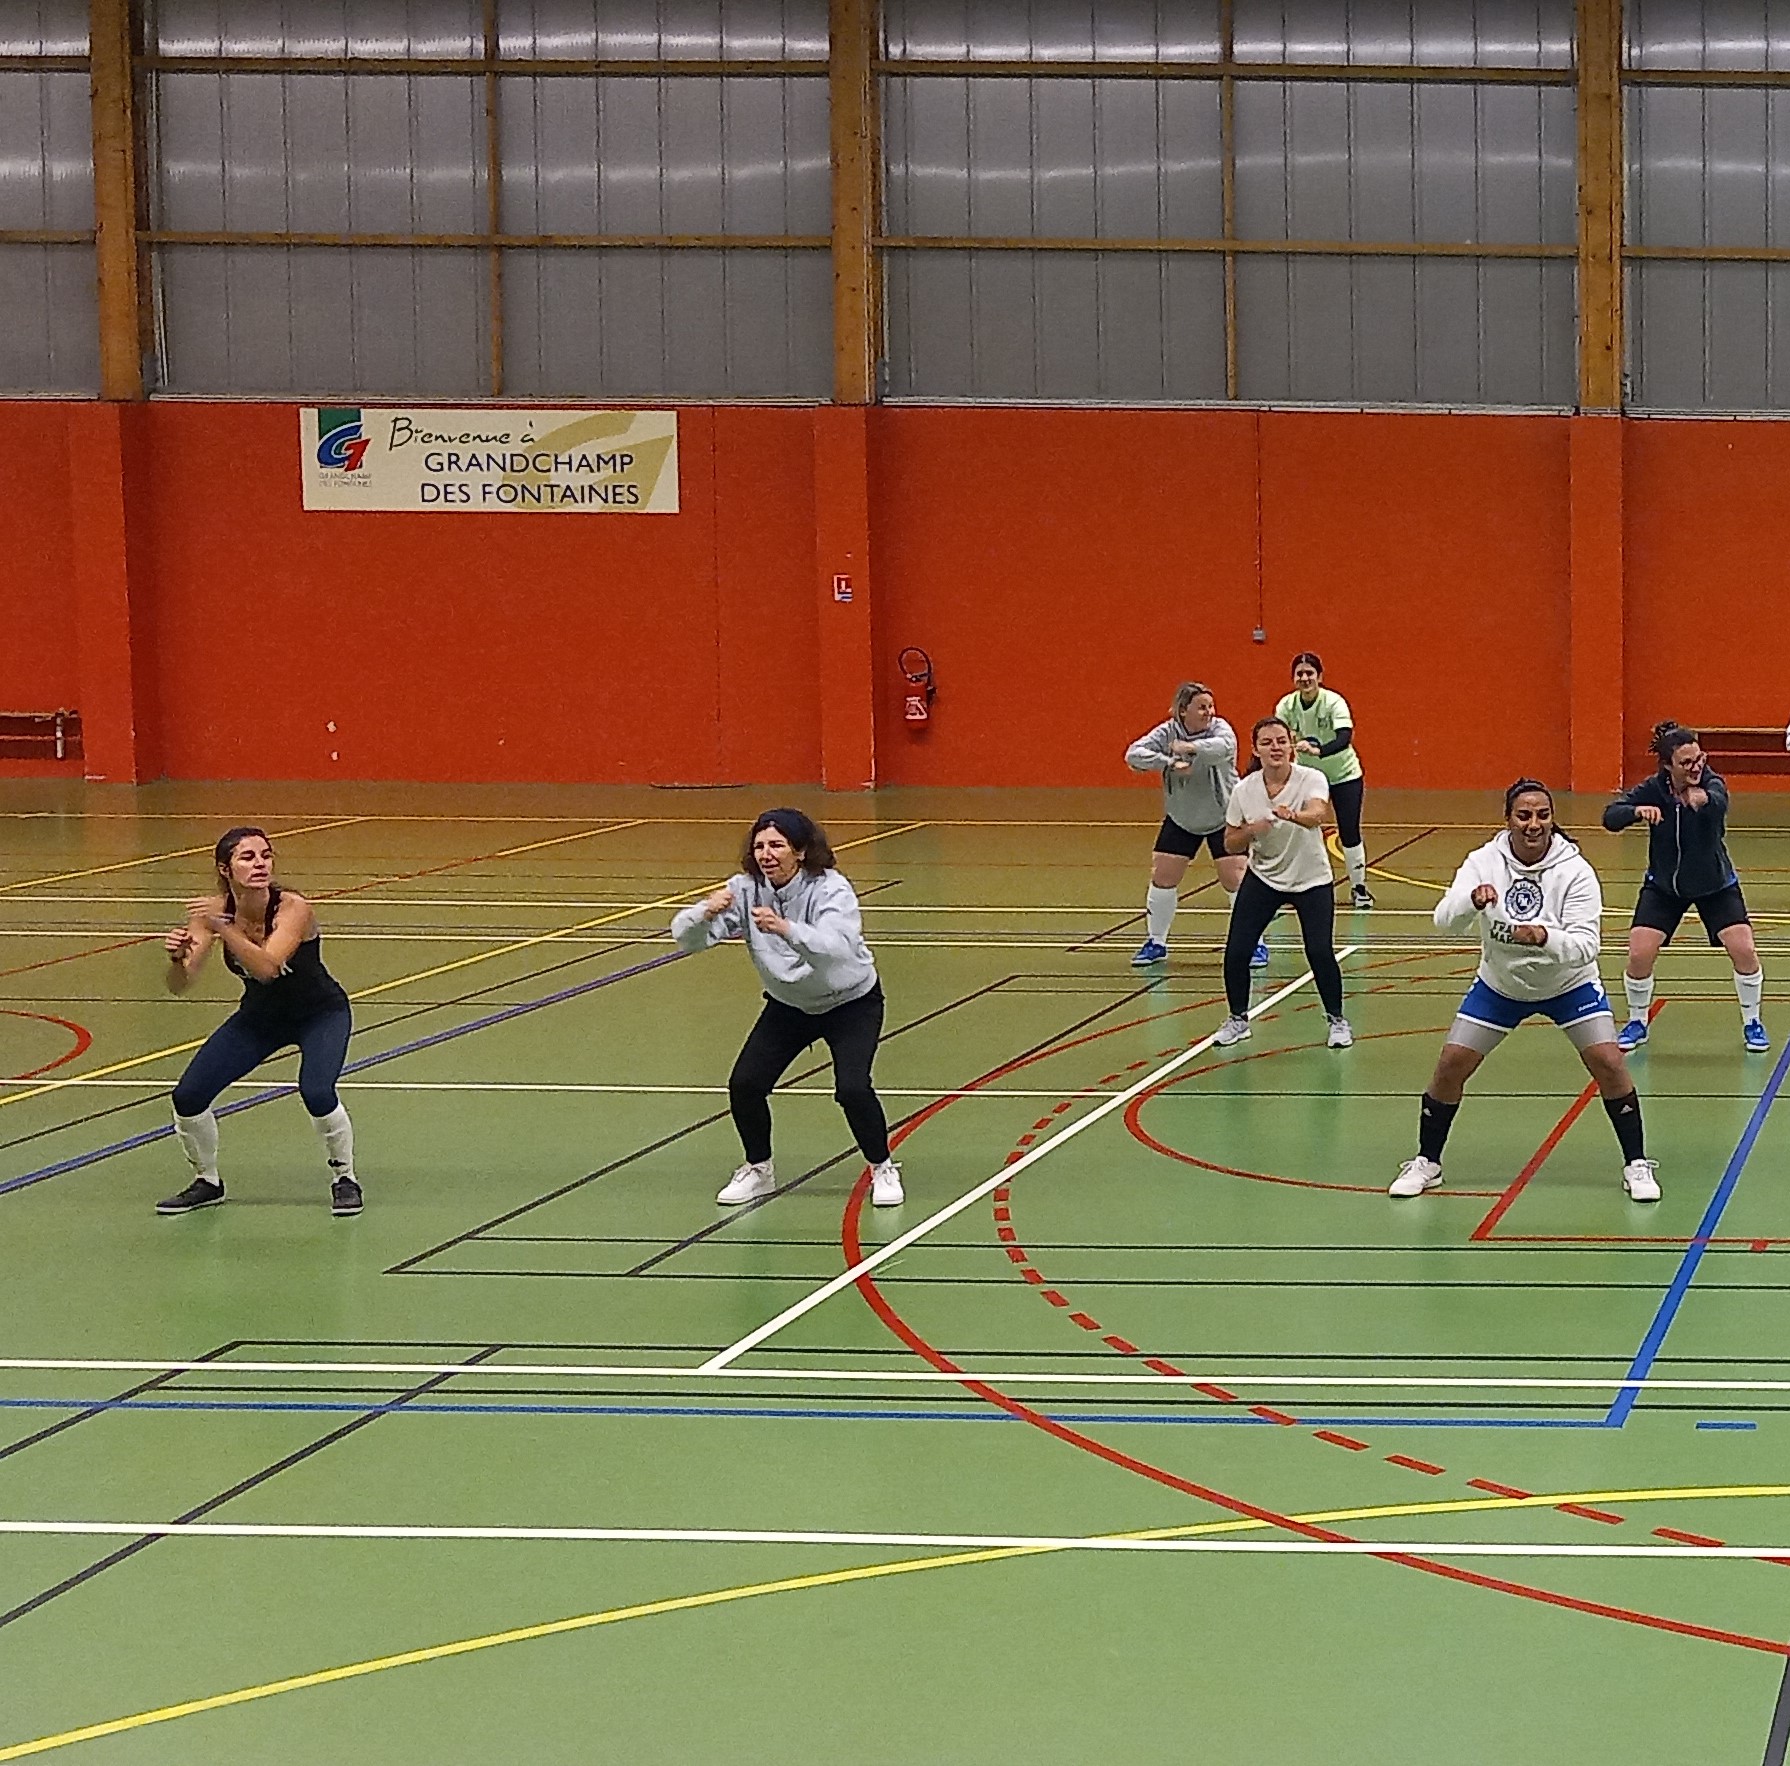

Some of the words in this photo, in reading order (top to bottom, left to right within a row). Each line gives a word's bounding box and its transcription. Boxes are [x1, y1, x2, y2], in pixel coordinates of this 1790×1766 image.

[388, 416, 511, 451] Bienvenue
[520, 420, 535, 444] à
[424, 452, 634, 473] GRANDCHAMP
[420, 483, 471, 503] DES
[482, 483, 640, 504] FONTAINES
